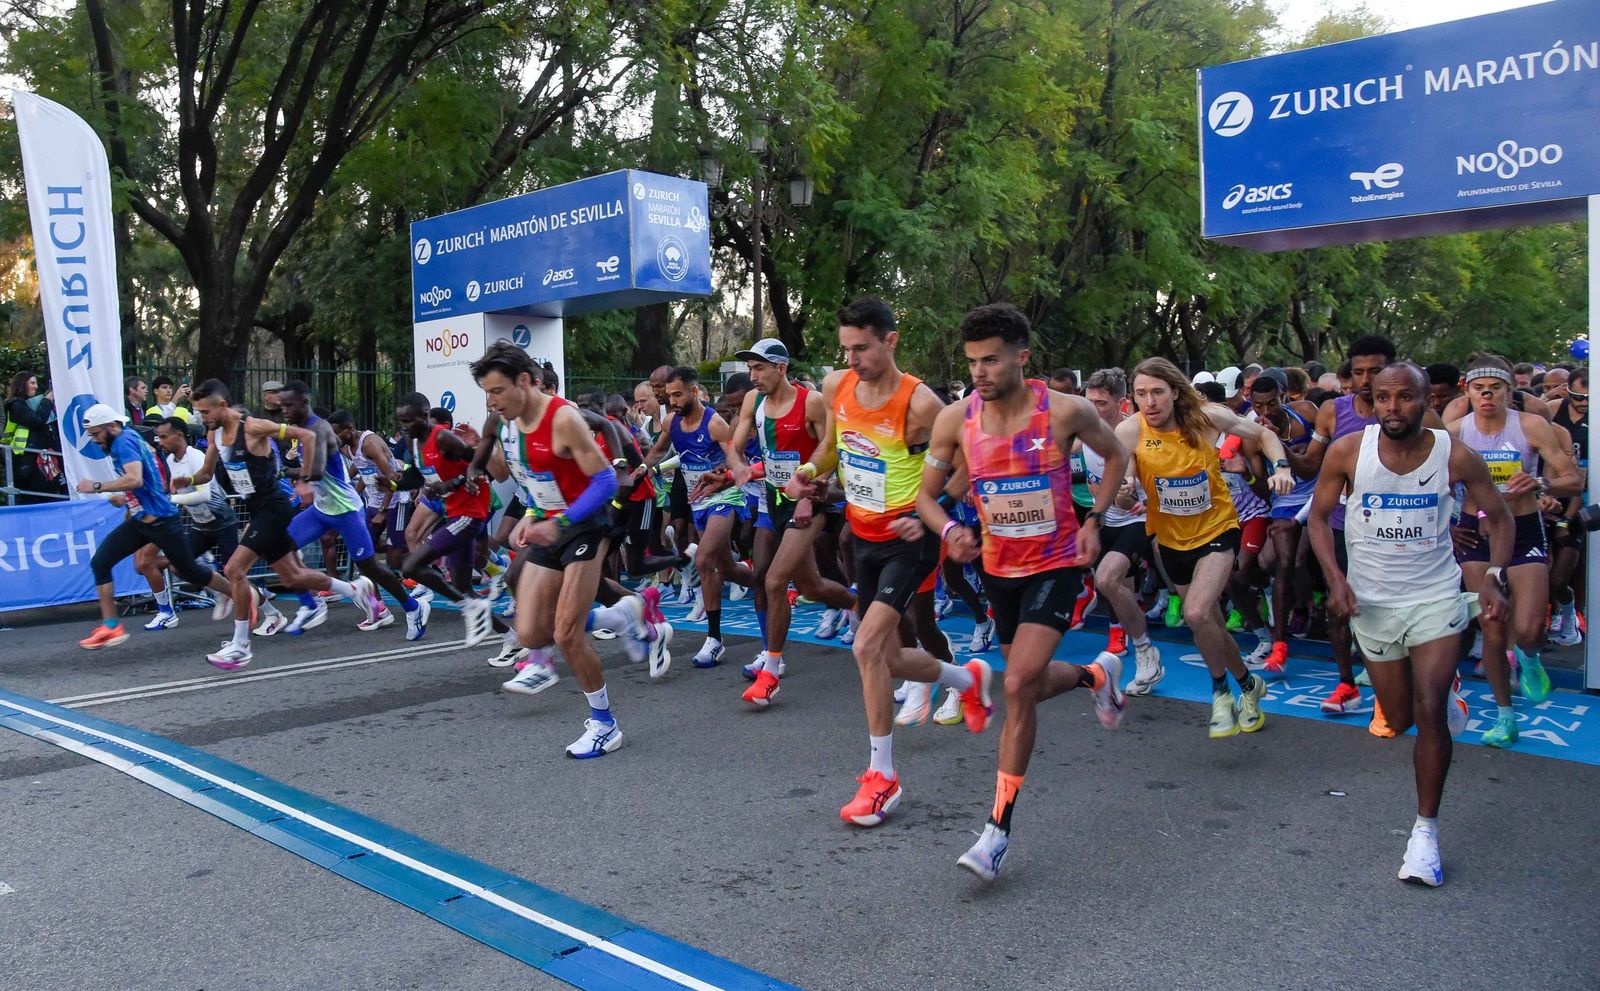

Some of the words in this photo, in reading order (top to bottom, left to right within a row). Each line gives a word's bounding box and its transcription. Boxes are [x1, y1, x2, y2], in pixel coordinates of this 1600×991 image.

[1268, 74, 1404, 120] ZURICH
[1424, 40, 1598, 95] MARATÓN
[648, 188, 680, 202] ZURICH
[1350, 190, 1404, 203] TotalEnergies
[648, 213, 681, 227] SEVILLA
[436, 230, 484, 256] ZURICH
[490, 215, 548, 244] MARATÓN
[551, 211, 567, 230] DE
[570, 200, 624, 226] SEVILLA
[484, 276, 523, 295] ZURICH
[1483, 452, 1514, 460] ZURICH
[1001, 479, 1040, 491] ZURICH
[1173, 475, 1202, 486] ZURICH
[1007, 499, 1023, 508] 158
[1164, 494, 1206, 507] ANDREW
[1387, 497, 1428, 506] ZURICH
[992, 509, 1045, 524] KHADIRI
[1396, 516, 1402, 524] 3
[1376, 526, 1423, 539] ASRAR
